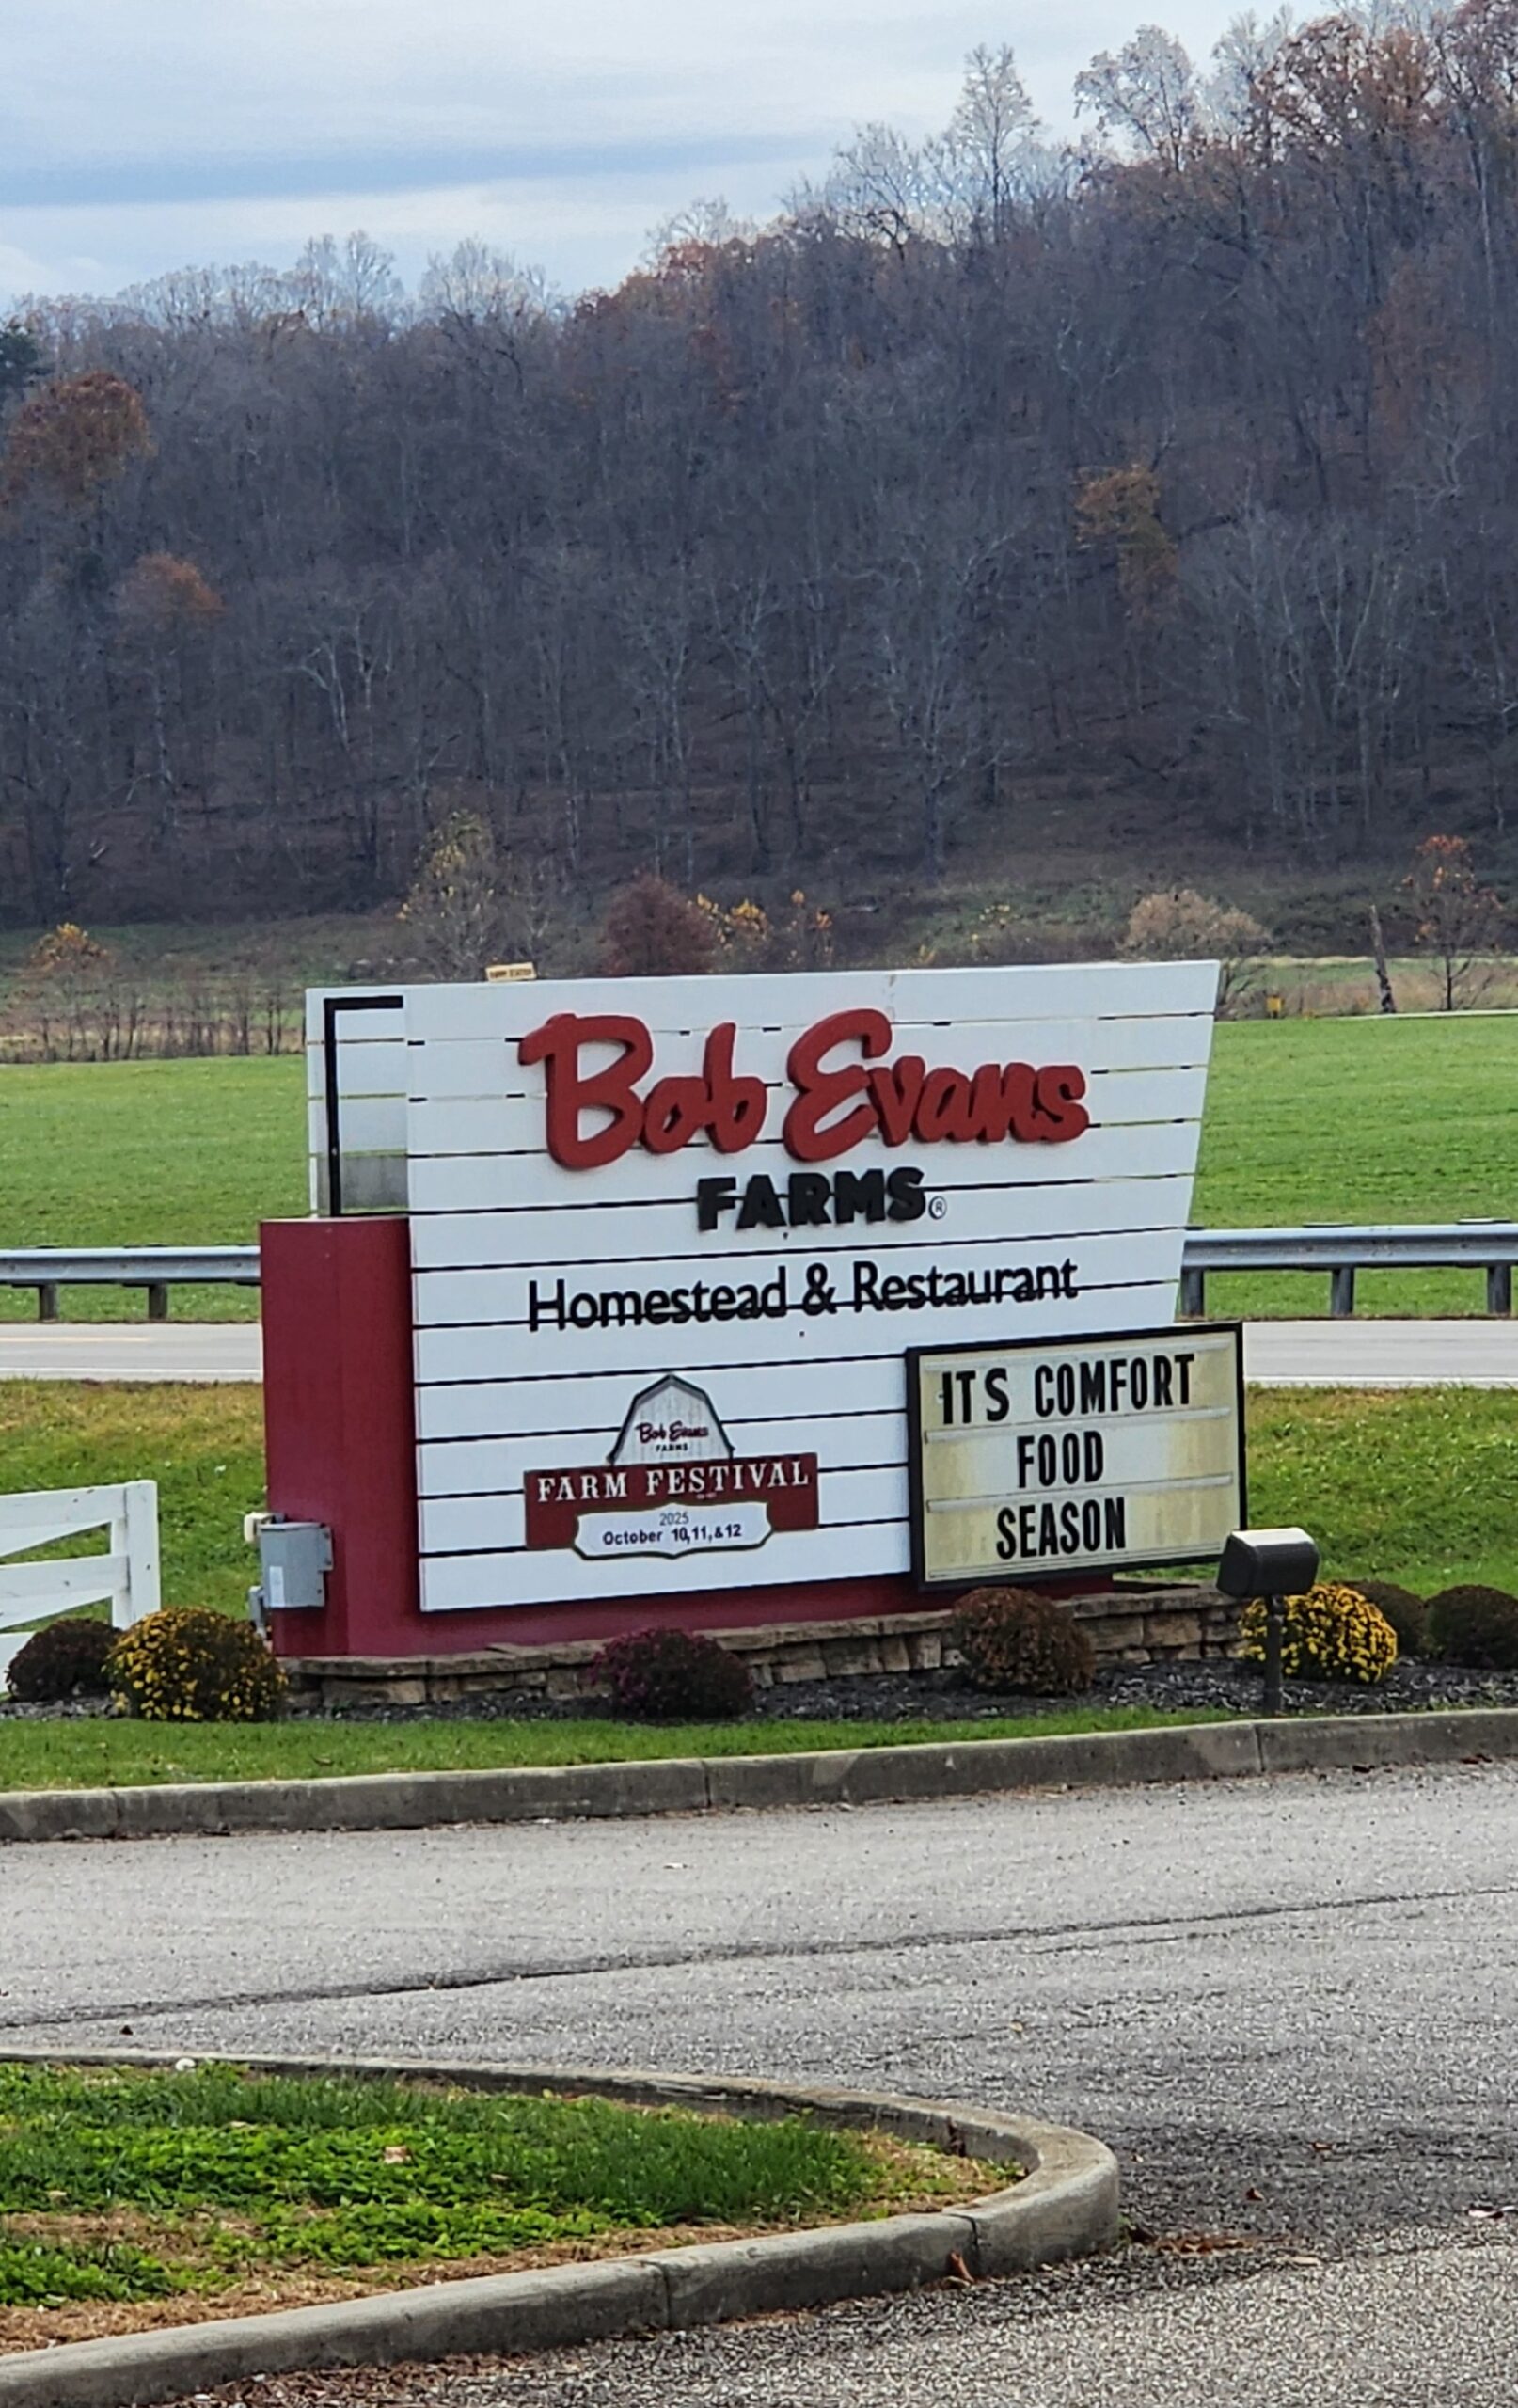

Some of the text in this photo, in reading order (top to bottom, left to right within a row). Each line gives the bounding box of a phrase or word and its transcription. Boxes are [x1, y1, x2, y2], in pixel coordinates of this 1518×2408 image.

[518, 1008, 1090, 1169] Bob Evans
[528, 1258, 1079, 1332] Homestead & Restaurant
[942, 1353, 1194, 1425] ITS COMFORT
[634, 1422, 667, 1444] Bob
[1017, 1430, 1104, 1489] FOOD
[537, 1460, 809, 1503] FARM FESTIVAL
[602, 1529, 663, 1545] October
[659, 1511, 689, 1526] 2025
[996, 1497, 1126, 1560] SEASON
